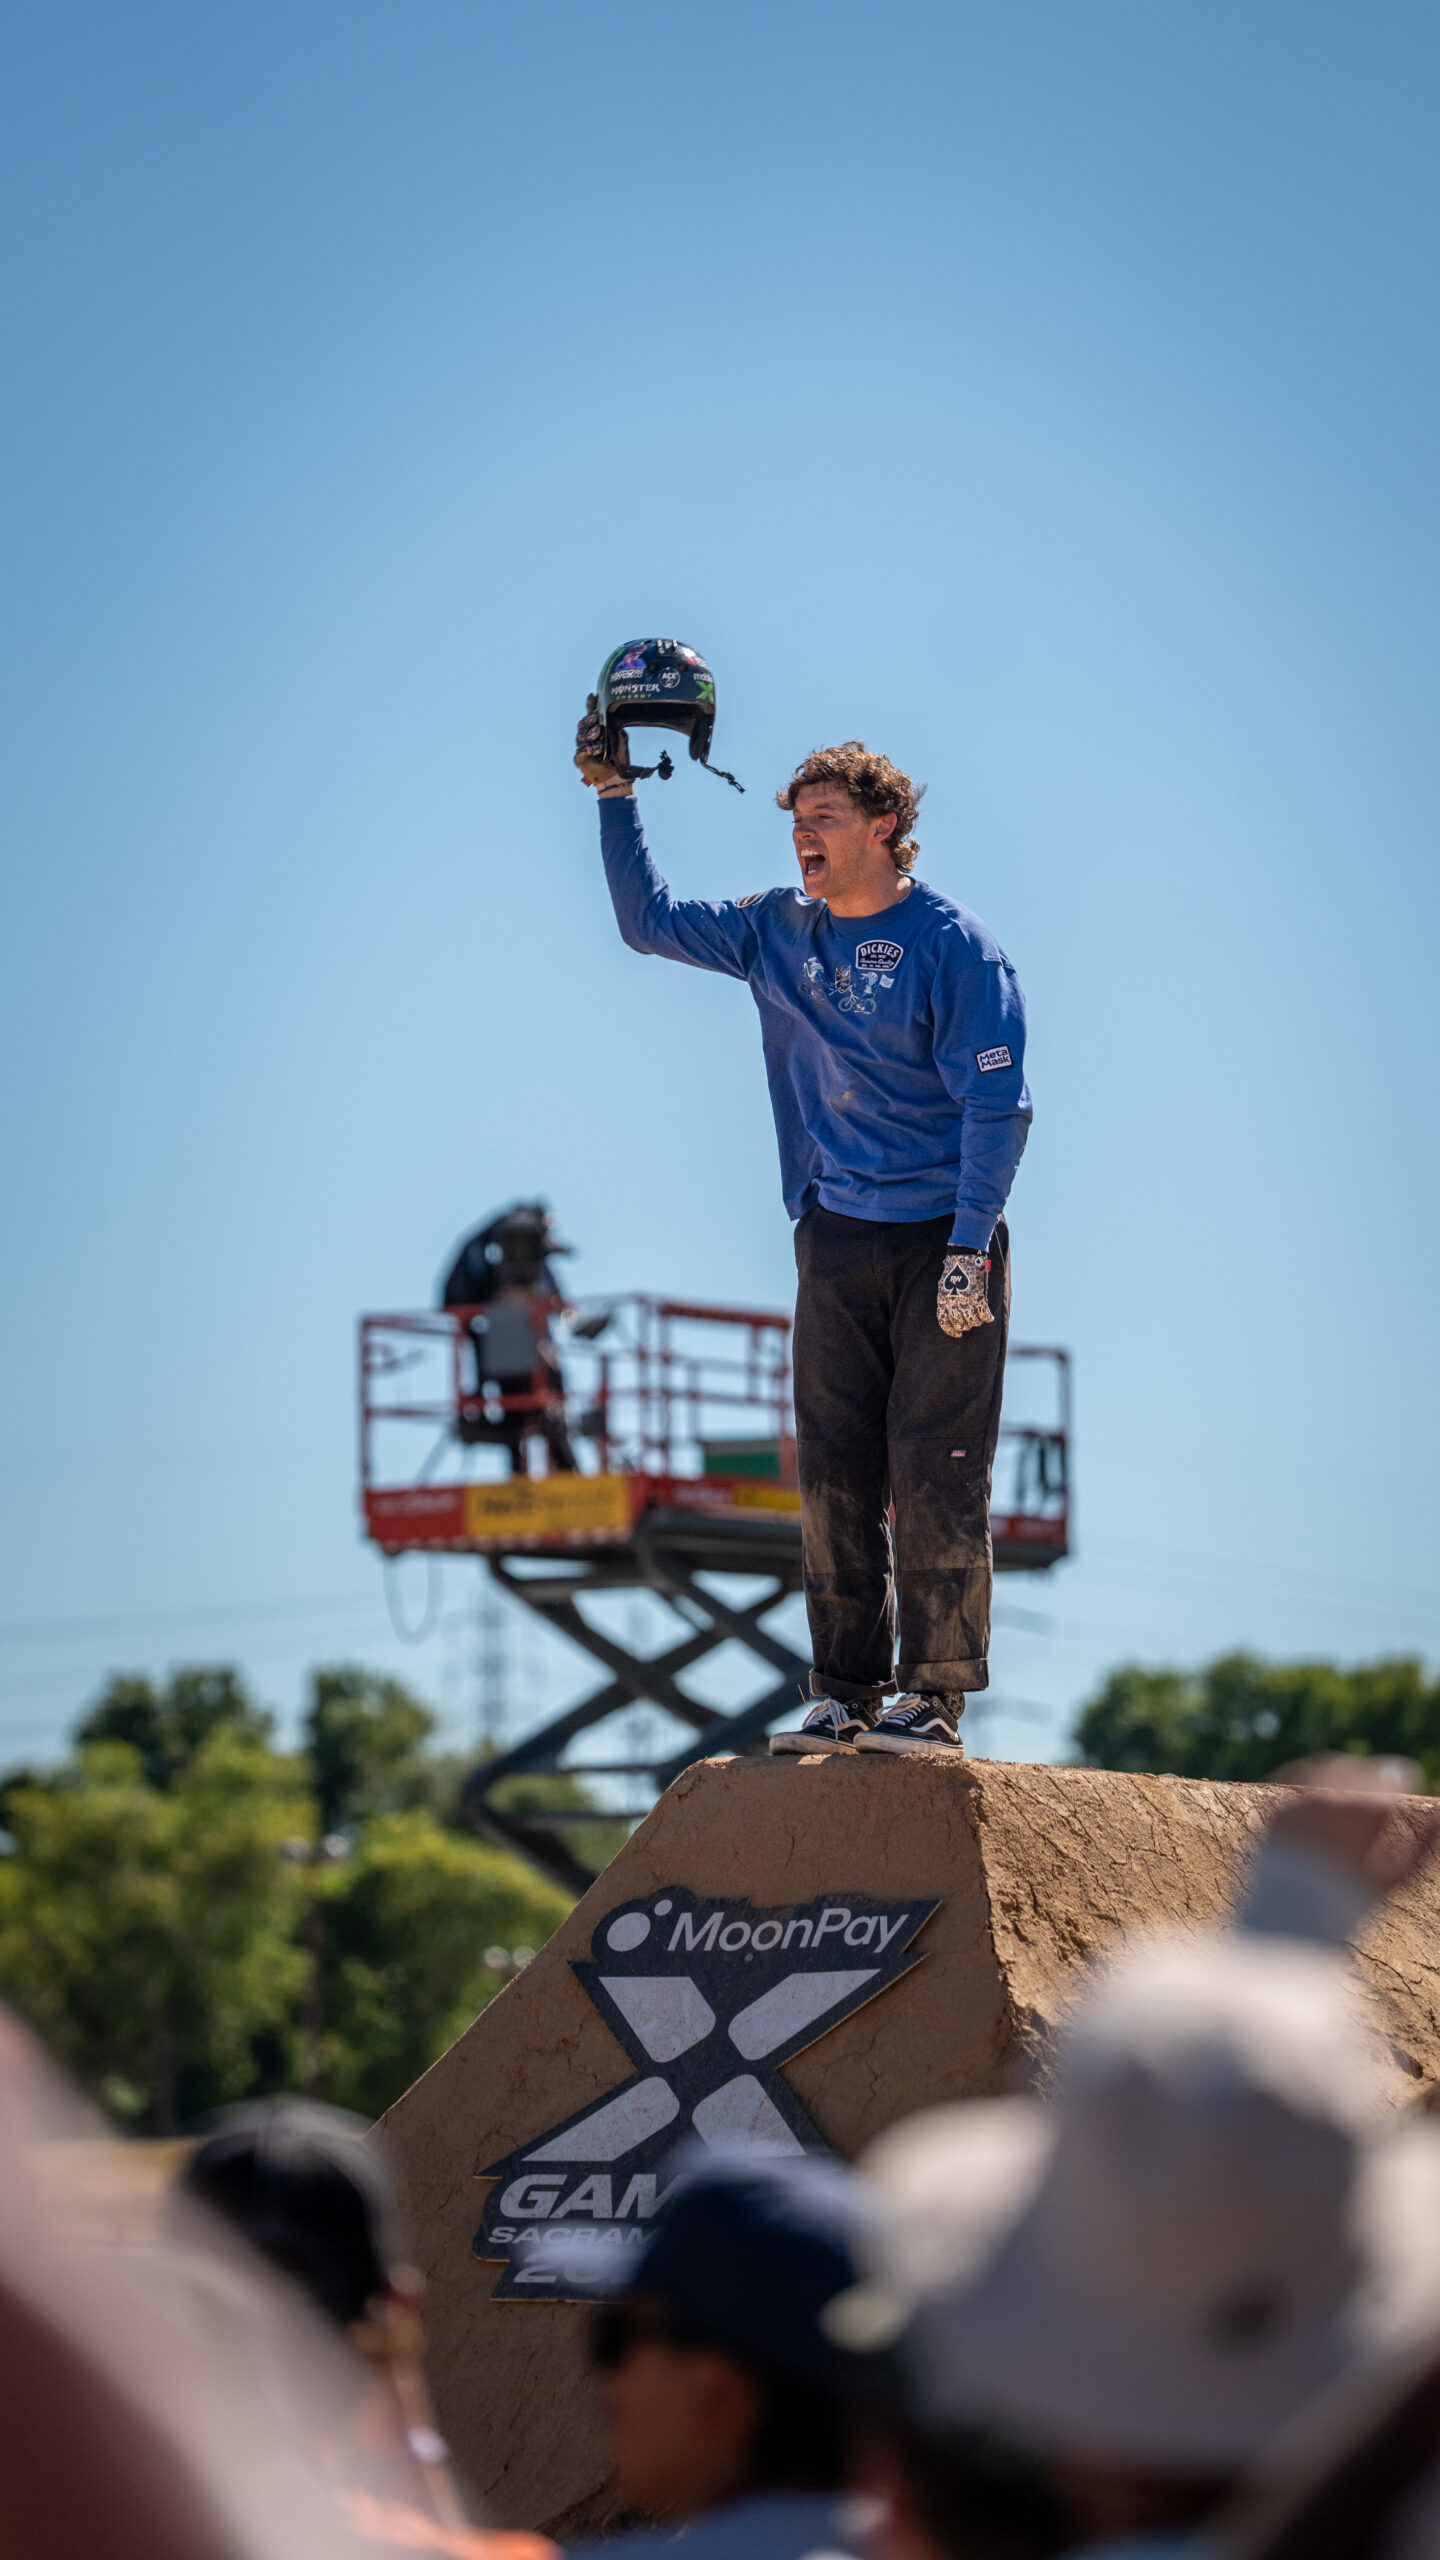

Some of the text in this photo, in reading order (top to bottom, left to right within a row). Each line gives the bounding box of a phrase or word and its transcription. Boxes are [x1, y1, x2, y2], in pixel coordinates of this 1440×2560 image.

[860, 944, 900, 958] DICKIES
[980, 1049, 1008, 1062] Meta
[981, 1056, 1010, 1069] Mask
[667, 1907, 909, 1953] MoonPay
[499, 2173, 690, 2219] GAM
[488, 2225, 660, 2245] SACRAM
